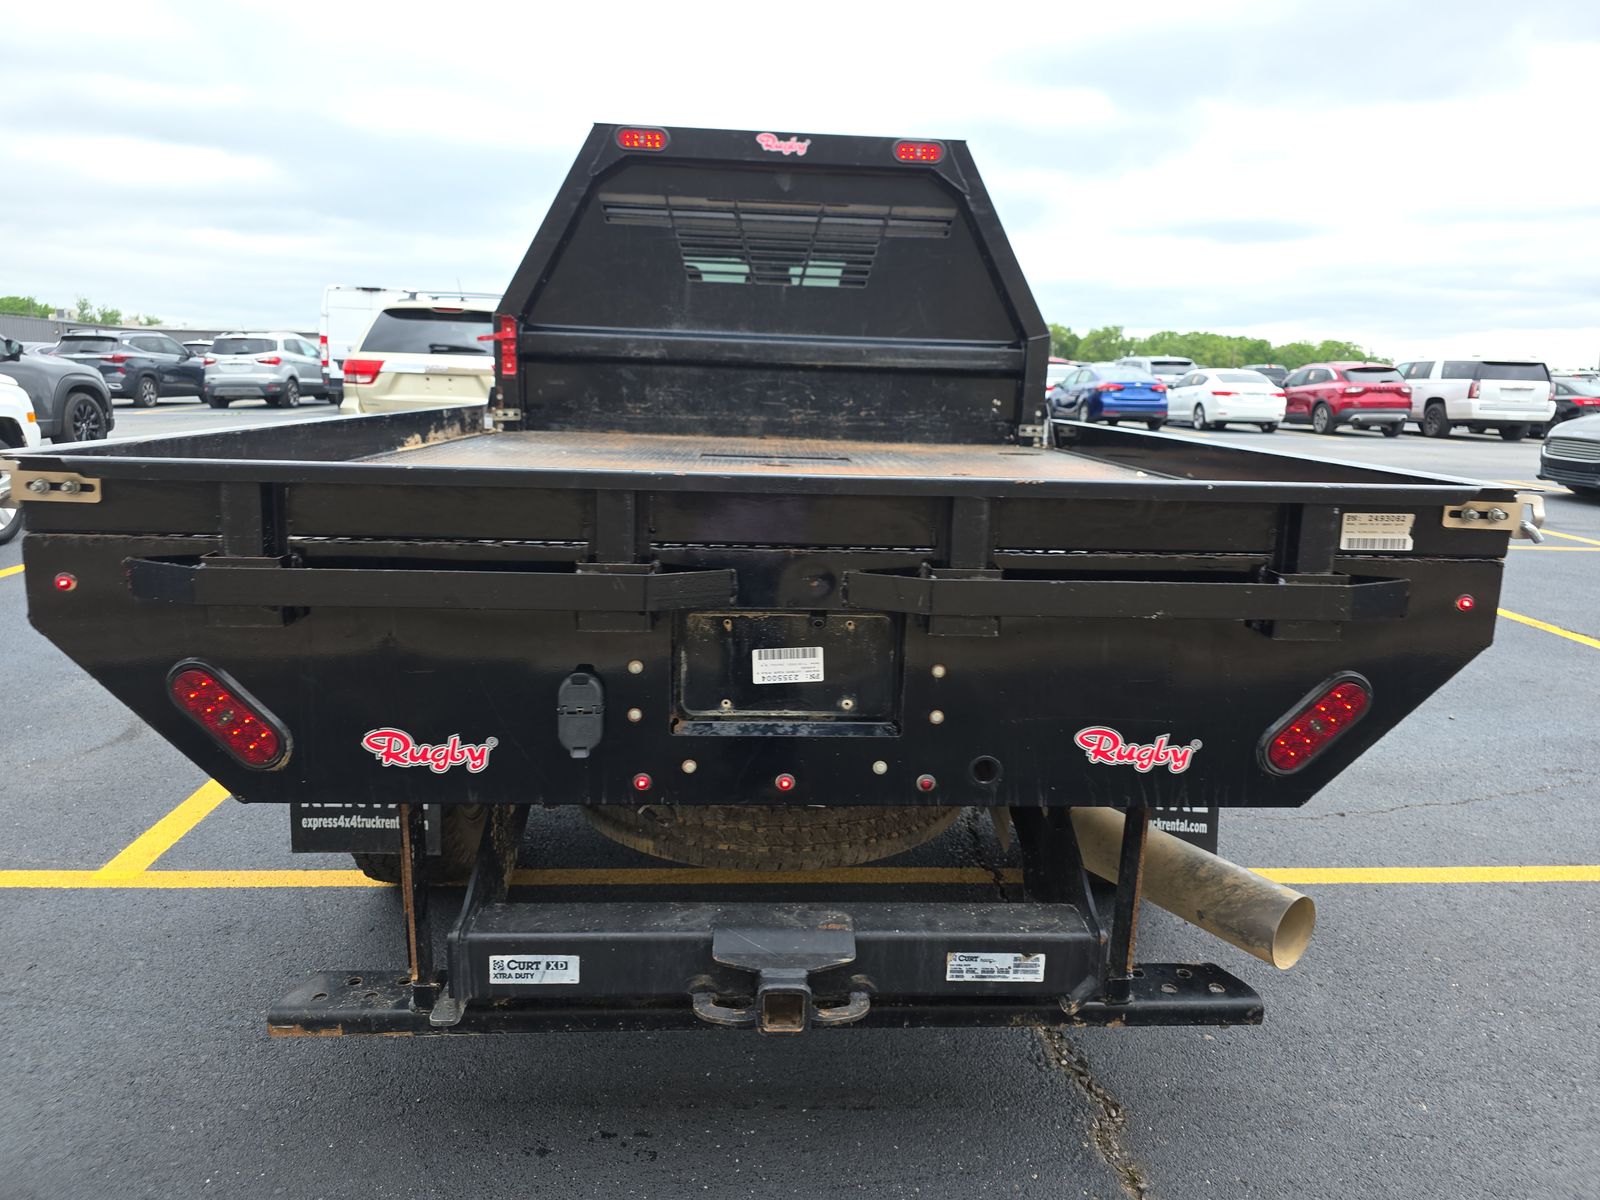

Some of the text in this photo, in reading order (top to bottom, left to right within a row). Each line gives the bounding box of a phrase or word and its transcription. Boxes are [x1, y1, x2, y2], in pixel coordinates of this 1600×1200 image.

[756, 132, 808, 156] Rugby
[361, 727, 491, 773] Rugby
[1074, 726, 1193, 774] Rugby
[547, 960, 568, 971] XD
